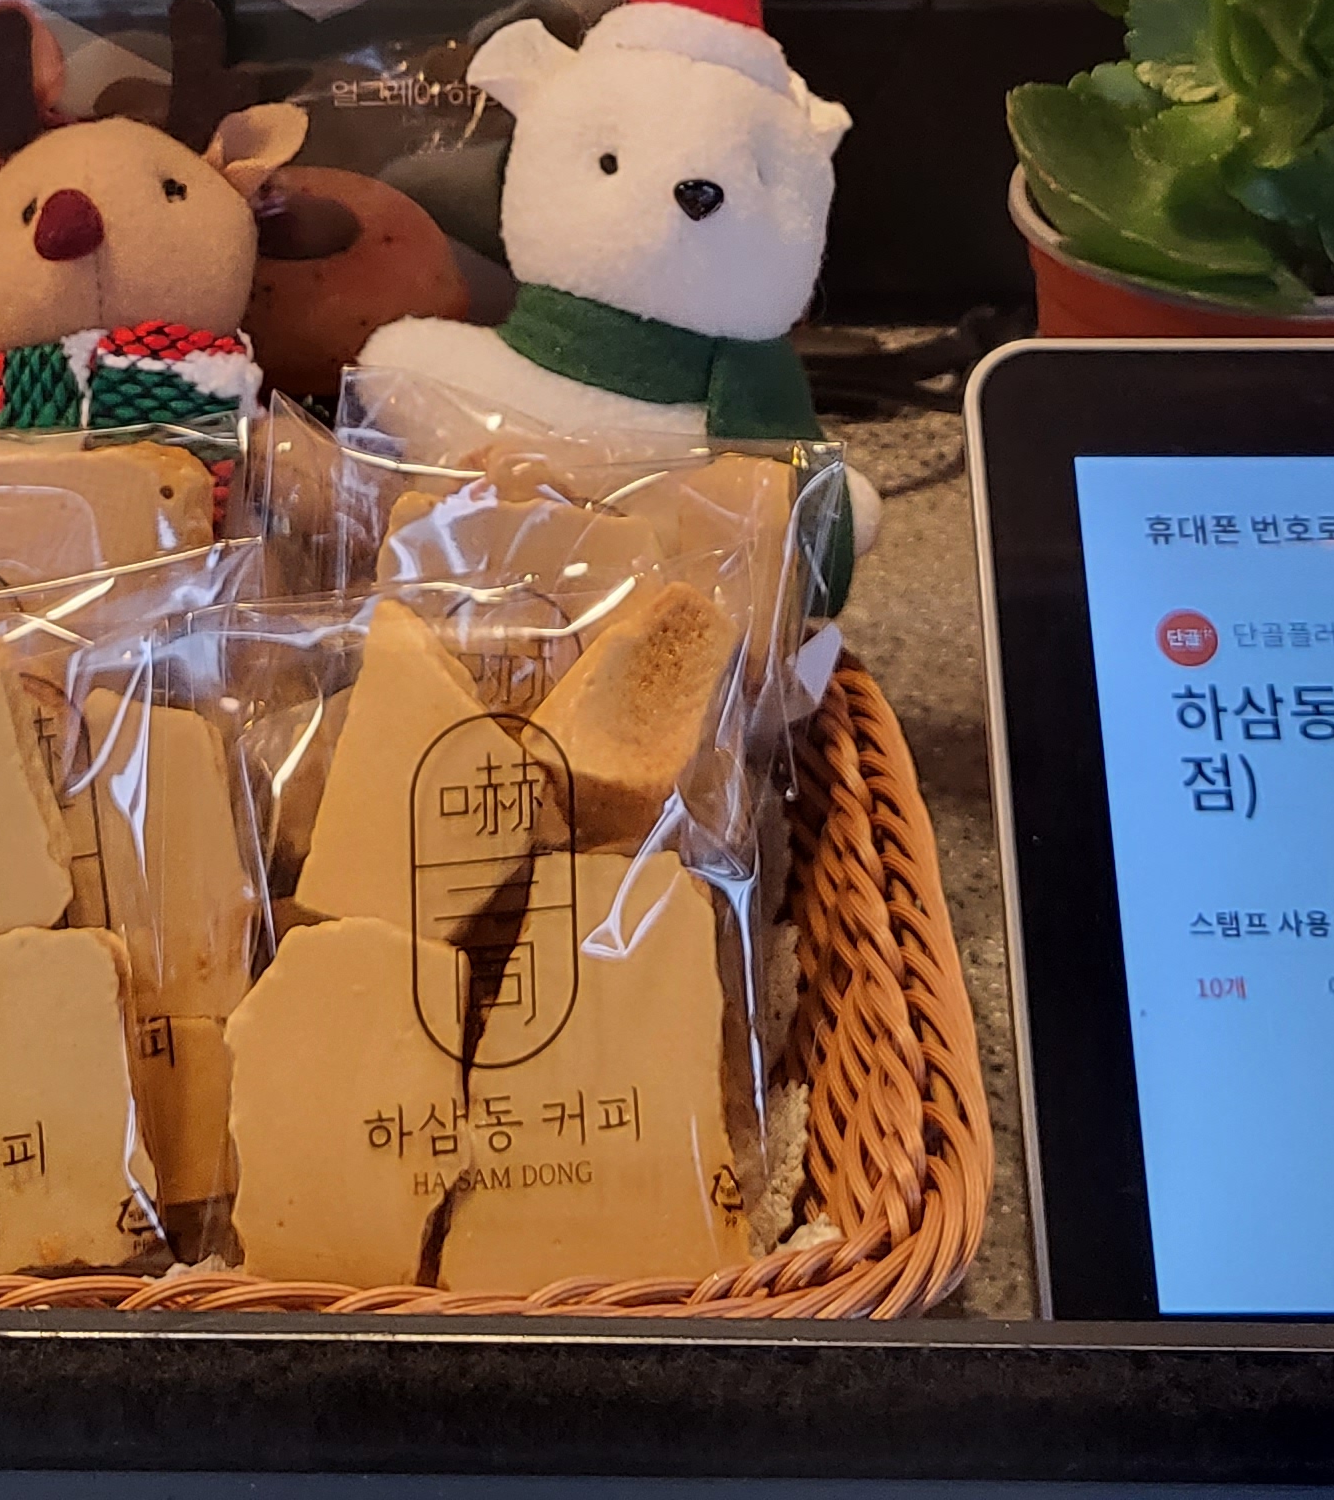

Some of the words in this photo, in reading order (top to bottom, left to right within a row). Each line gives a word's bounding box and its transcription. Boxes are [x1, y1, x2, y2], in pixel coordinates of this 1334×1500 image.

[1145, 514, 1241, 546] 휴대폰
[1180, 752, 1260, 819] 점)
[1278, 910, 1332, 938] 사용
[1197, 975, 1247, 1000] 10개
[413, 1170, 447, 1195] HA
[458, 1165, 513, 1192] SAM
[522, 1160, 593, 1186] DONG
